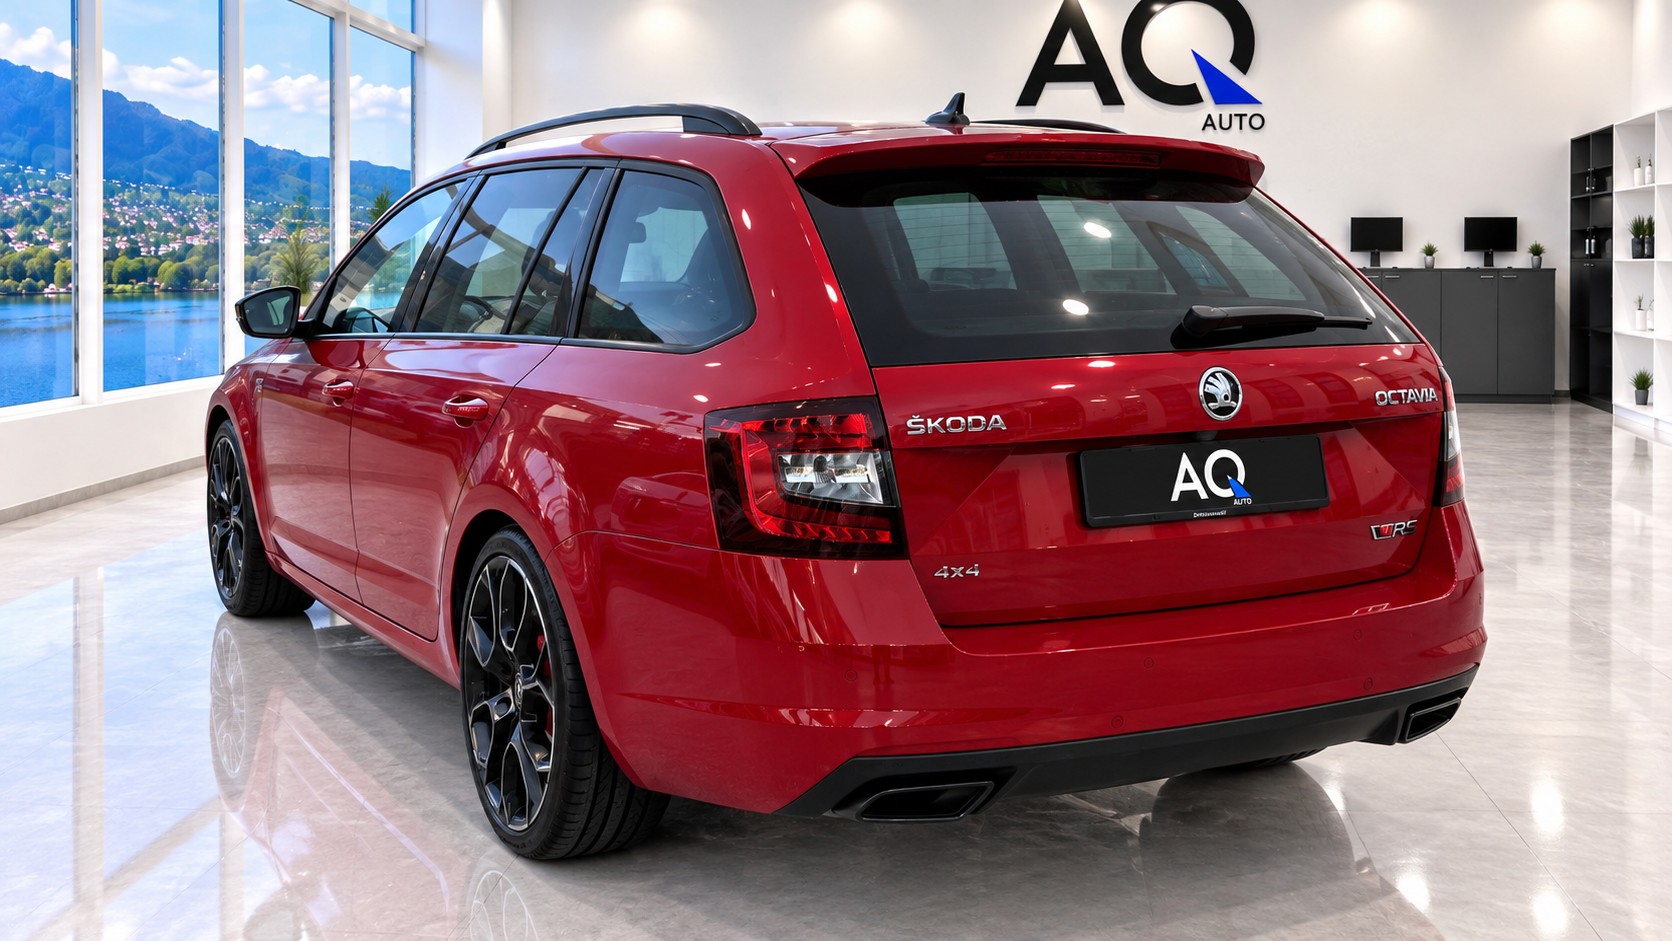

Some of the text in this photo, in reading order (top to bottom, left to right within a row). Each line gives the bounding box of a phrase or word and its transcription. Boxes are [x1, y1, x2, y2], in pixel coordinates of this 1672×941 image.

[1016, 0, 1263, 106] AQ
[1202, 113, 1265, 131] AUTO
[1375, 387, 1438, 406] OCTAVIA
[906, 414, 1007, 435] ŠKODA
[1170, 449, 1252, 502] AQ
[934, 563, 980, 578] 4x4
